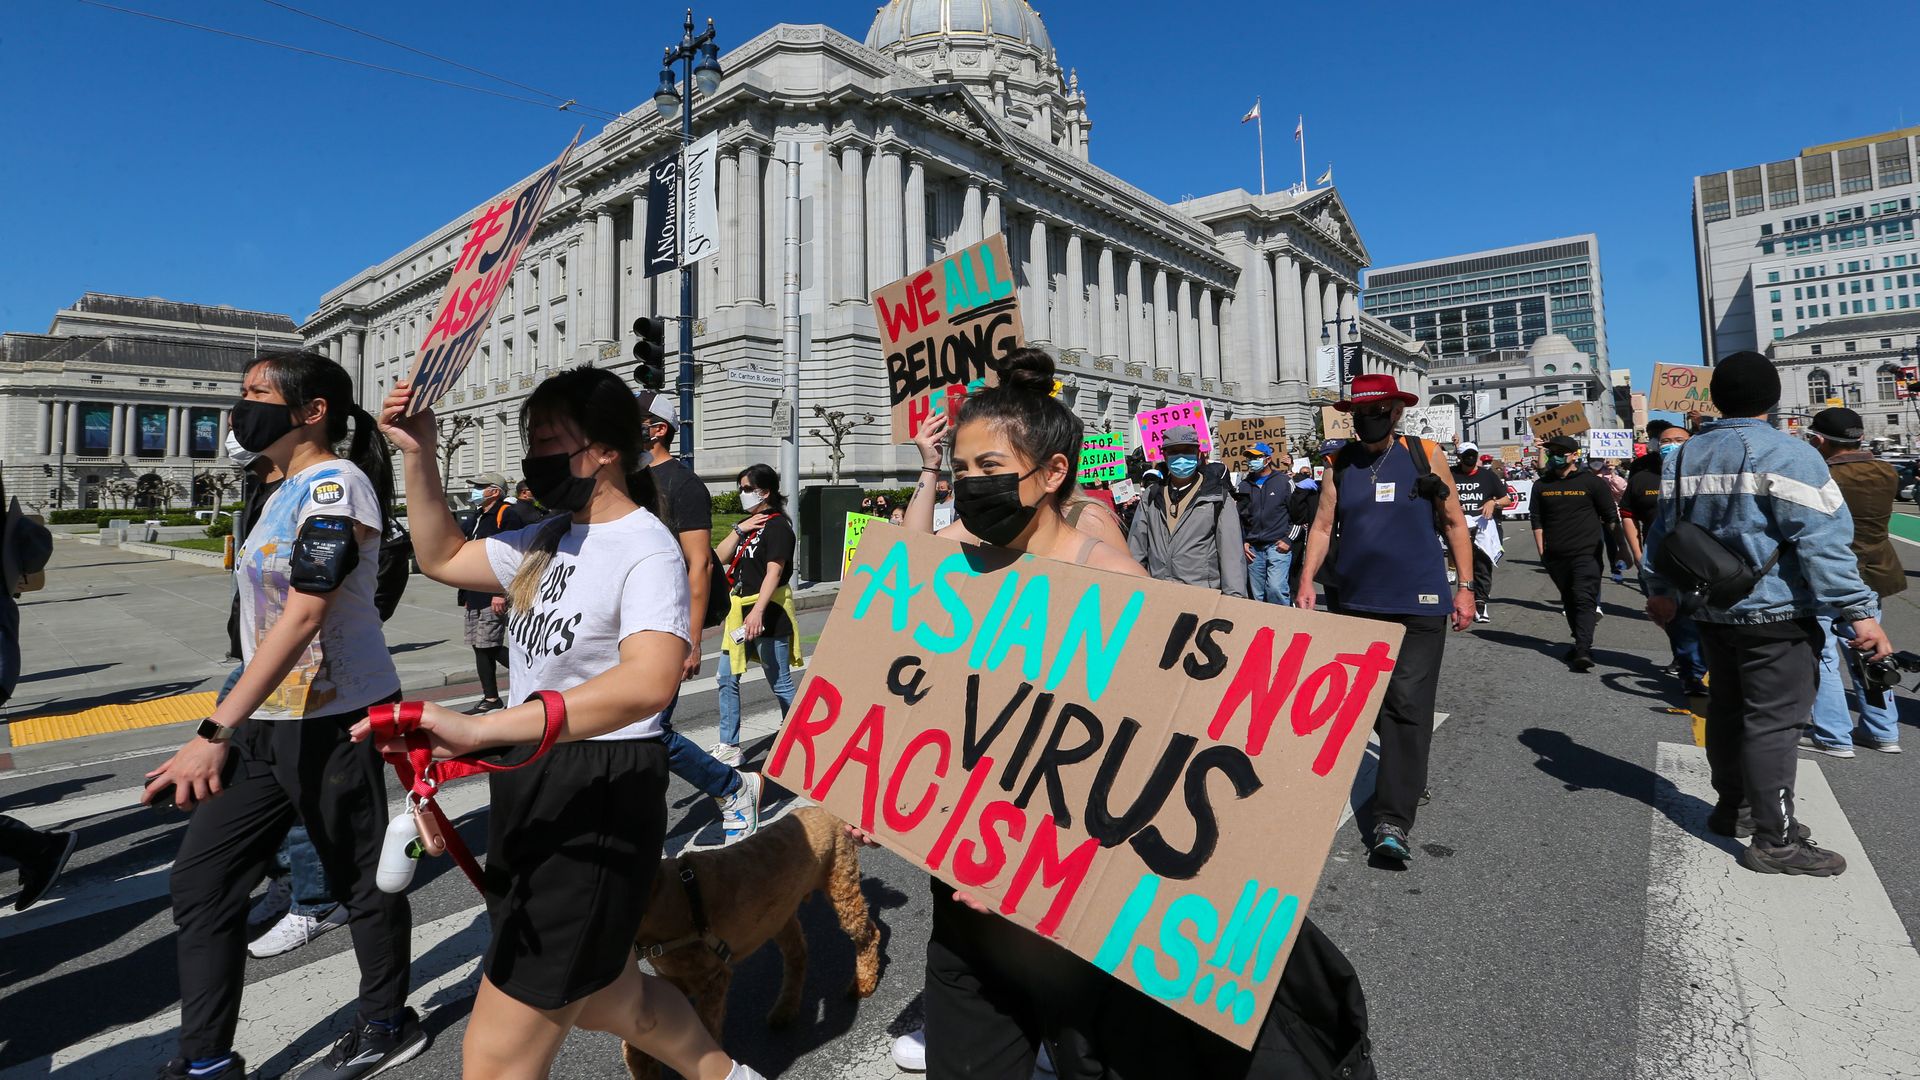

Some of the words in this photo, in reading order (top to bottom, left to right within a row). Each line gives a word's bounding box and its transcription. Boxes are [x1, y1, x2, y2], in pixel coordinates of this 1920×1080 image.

[454, 160, 562, 275] #STO
[421, 248, 518, 351] ASIAN
[877, 270, 940, 344] WE
[943, 244, 1012, 314] ALL
[886, 312, 1017, 408] BELONG
[1661, 372, 1697, 386] STOP
[1151, 408, 1191, 425] STOP
[1534, 411, 1558, 426] STOP
[1241, 419, 1265, 430] END
[1220, 428, 1286, 445] VIOLENCE
[1540, 428, 1563, 442] HATE
[1592, 431, 1633, 440] RACISM
[1083, 437, 1113, 451] STOP
[1222, 442, 1284, 458] AGAST
[1082, 452, 1116, 465] ASIAN
[1595, 449, 1629, 457] VIRUS
[1084, 466, 1115, 478] HATE
[316, 484, 340, 493] STOP
[1456, 483, 1480, 491] STOP
[317, 492, 340, 501] HATE
[1458, 493, 1483, 501] SIAN
[853, 541, 1145, 702] ASIAN
[1159, 612, 1234, 681] IS
[887, 655, 932, 705] a
[962, 673, 1263, 880] VIRUS
[768, 676, 1101, 937] RACISM
